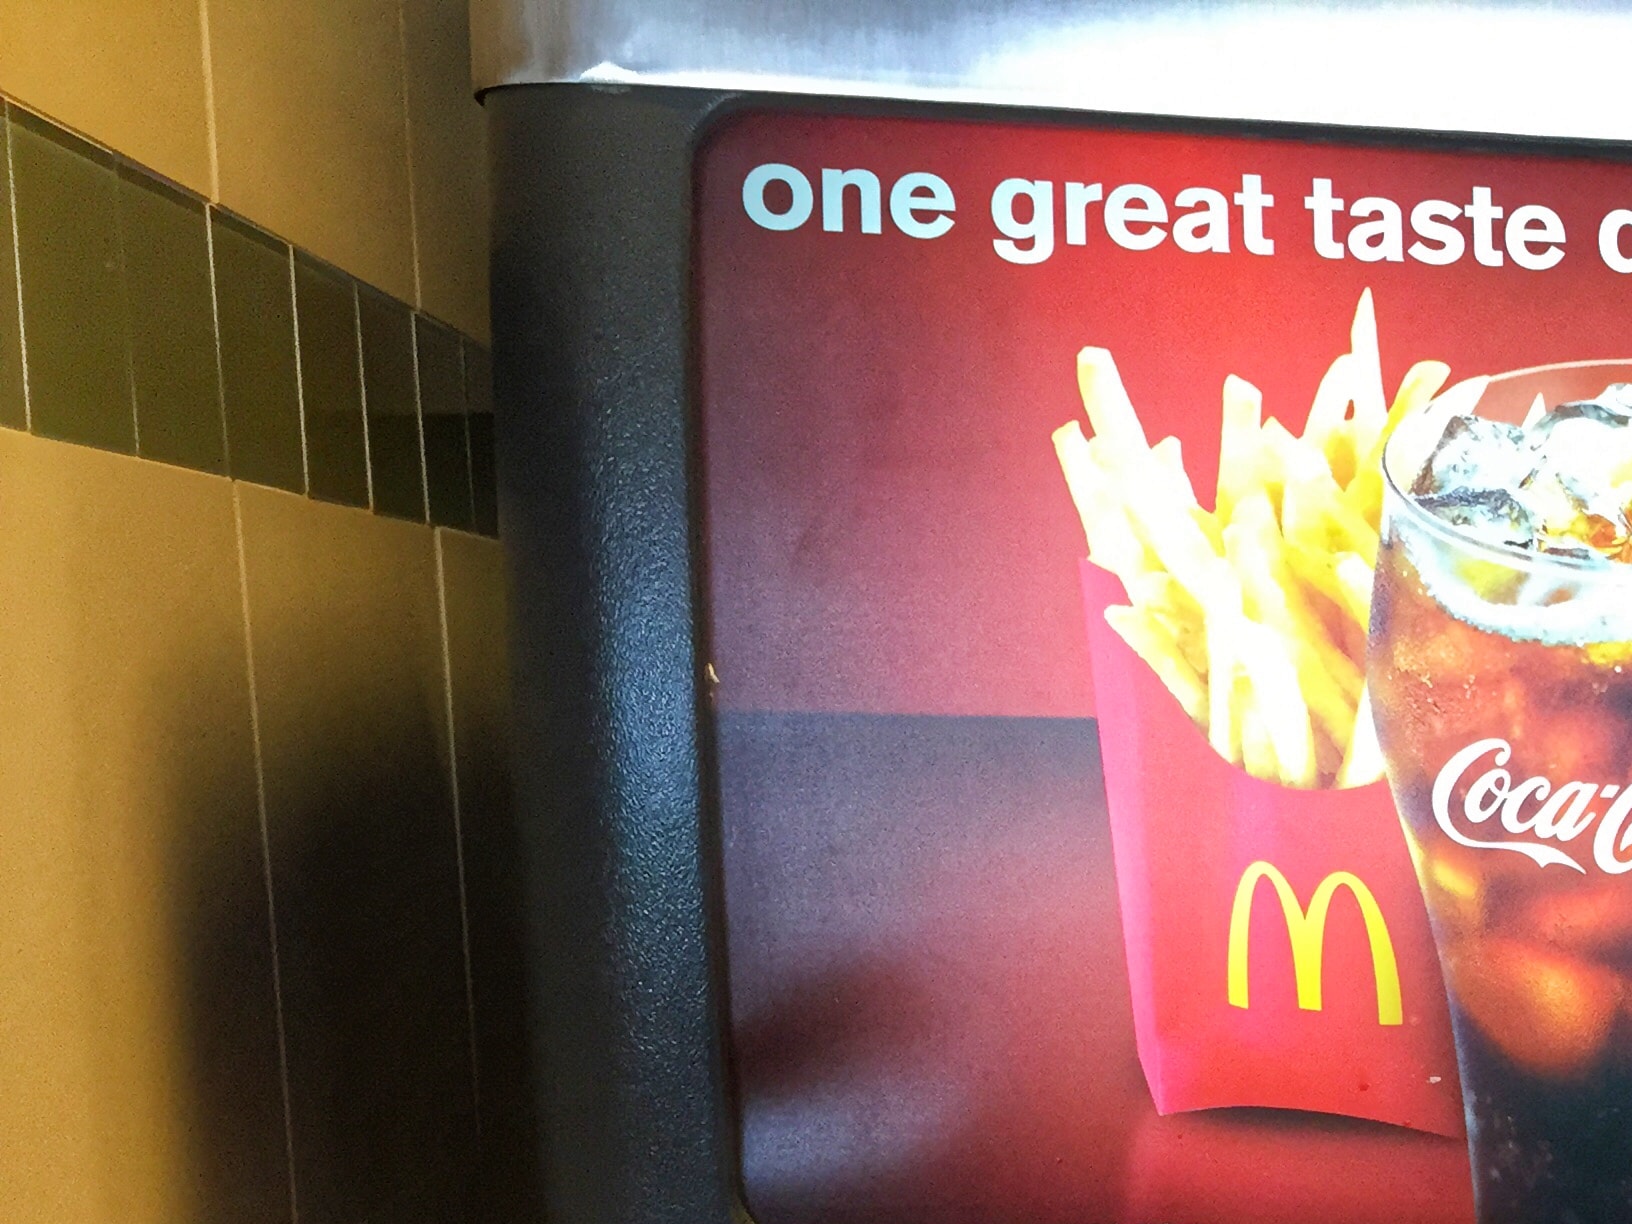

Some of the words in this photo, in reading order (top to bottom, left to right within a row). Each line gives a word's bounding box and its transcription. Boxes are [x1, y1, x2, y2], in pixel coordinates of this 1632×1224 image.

[742, 163, 956, 240] one
[991, 175, 1274, 265] great
[1305, 180, 1566, 271] taste
